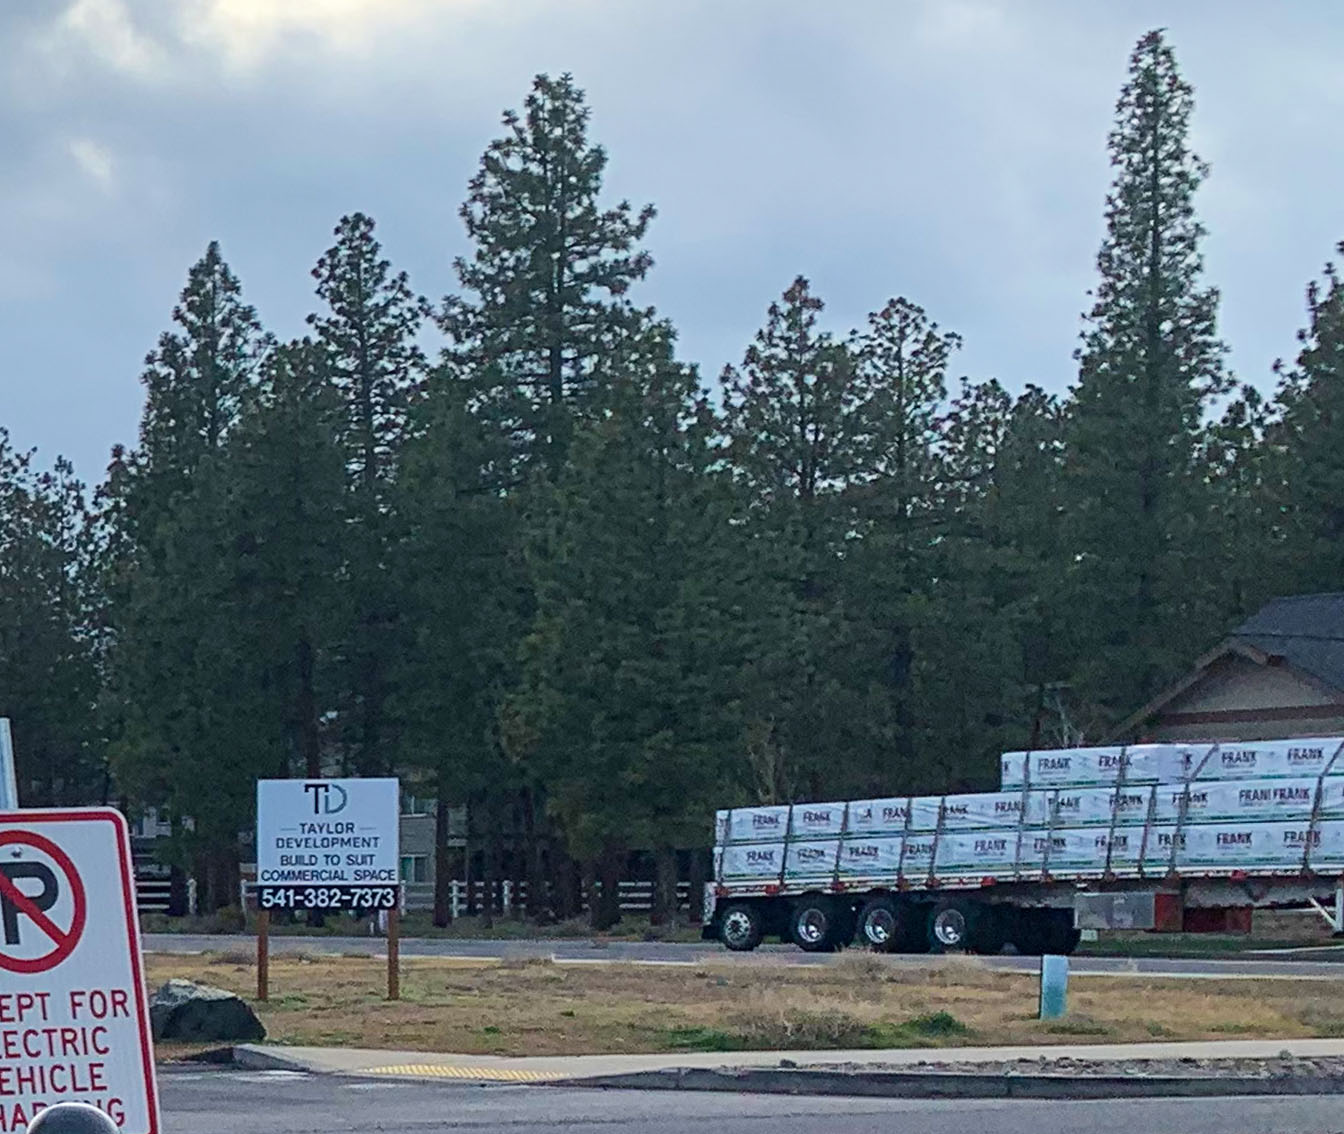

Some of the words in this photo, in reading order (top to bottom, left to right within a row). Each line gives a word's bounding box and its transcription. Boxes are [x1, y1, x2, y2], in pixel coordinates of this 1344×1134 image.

[1221, 751, 1256, 763] FRANK
[1287, 748, 1324, 761] FRANK
[1273, 788, 1310, 800] FRANK
[298, 822, 355, 834] TAYLOR
[275, 836, 381, 849] DEVELOPMENT
[1216, 832, 1252, 845] FRANK
[280, 854, 318, 866] BUILD
[323, 854, 341, 866] TO
[346, 854, 376, 866] SUIT
[261, 869, 348, 881] COMMERCIAL
[354, 869, 396, 881] SPACE
[262, 887, 395, 908] 541-382-7373
[70, 989, 130, 1019] FOR
